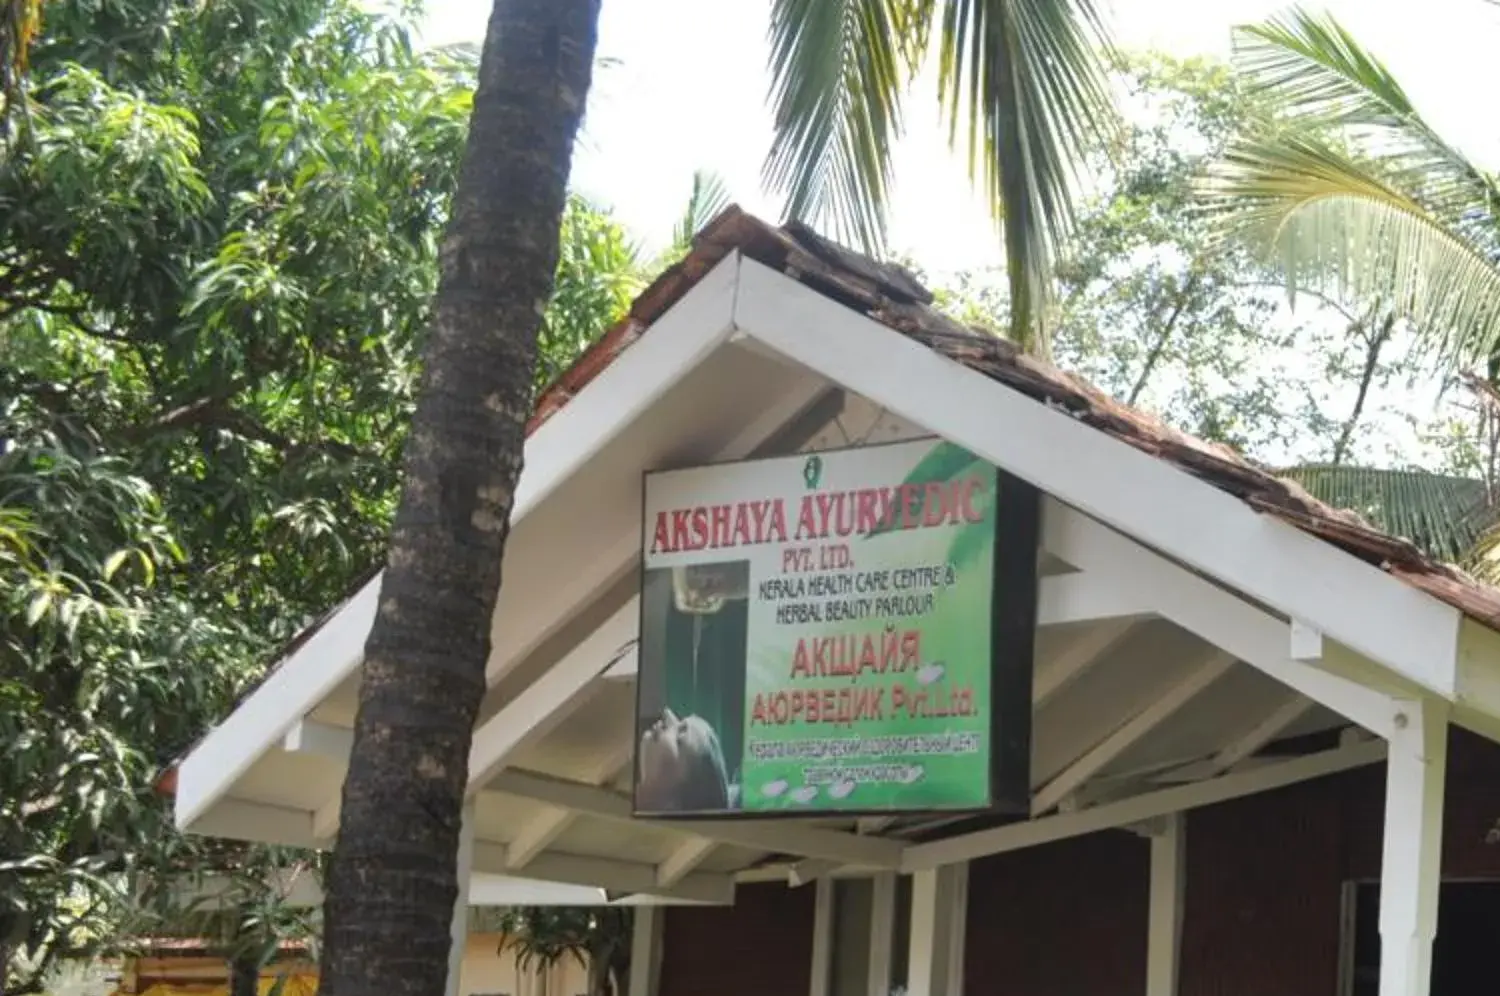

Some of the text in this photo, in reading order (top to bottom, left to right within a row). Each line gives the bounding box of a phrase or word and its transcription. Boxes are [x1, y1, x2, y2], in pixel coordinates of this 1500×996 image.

[649, 478, 986, 555] AKSHAYA AYURVEDIC
[782, 544, 855, 573] PVT. LTD.
[759, 579, 806, 601] KERALA
[808, 573, 853, 597] HEALTH
[855, 570, 889, 593] CARE
[893, 566, 942, 590] CENTRE
[776, 594, 934, 625] HERBAL BEAUTY PARLOUR
[789, 624, 920, 683] АКЩАЙЯ
[750, 687, 884, 728] АЮРВЕДИК
